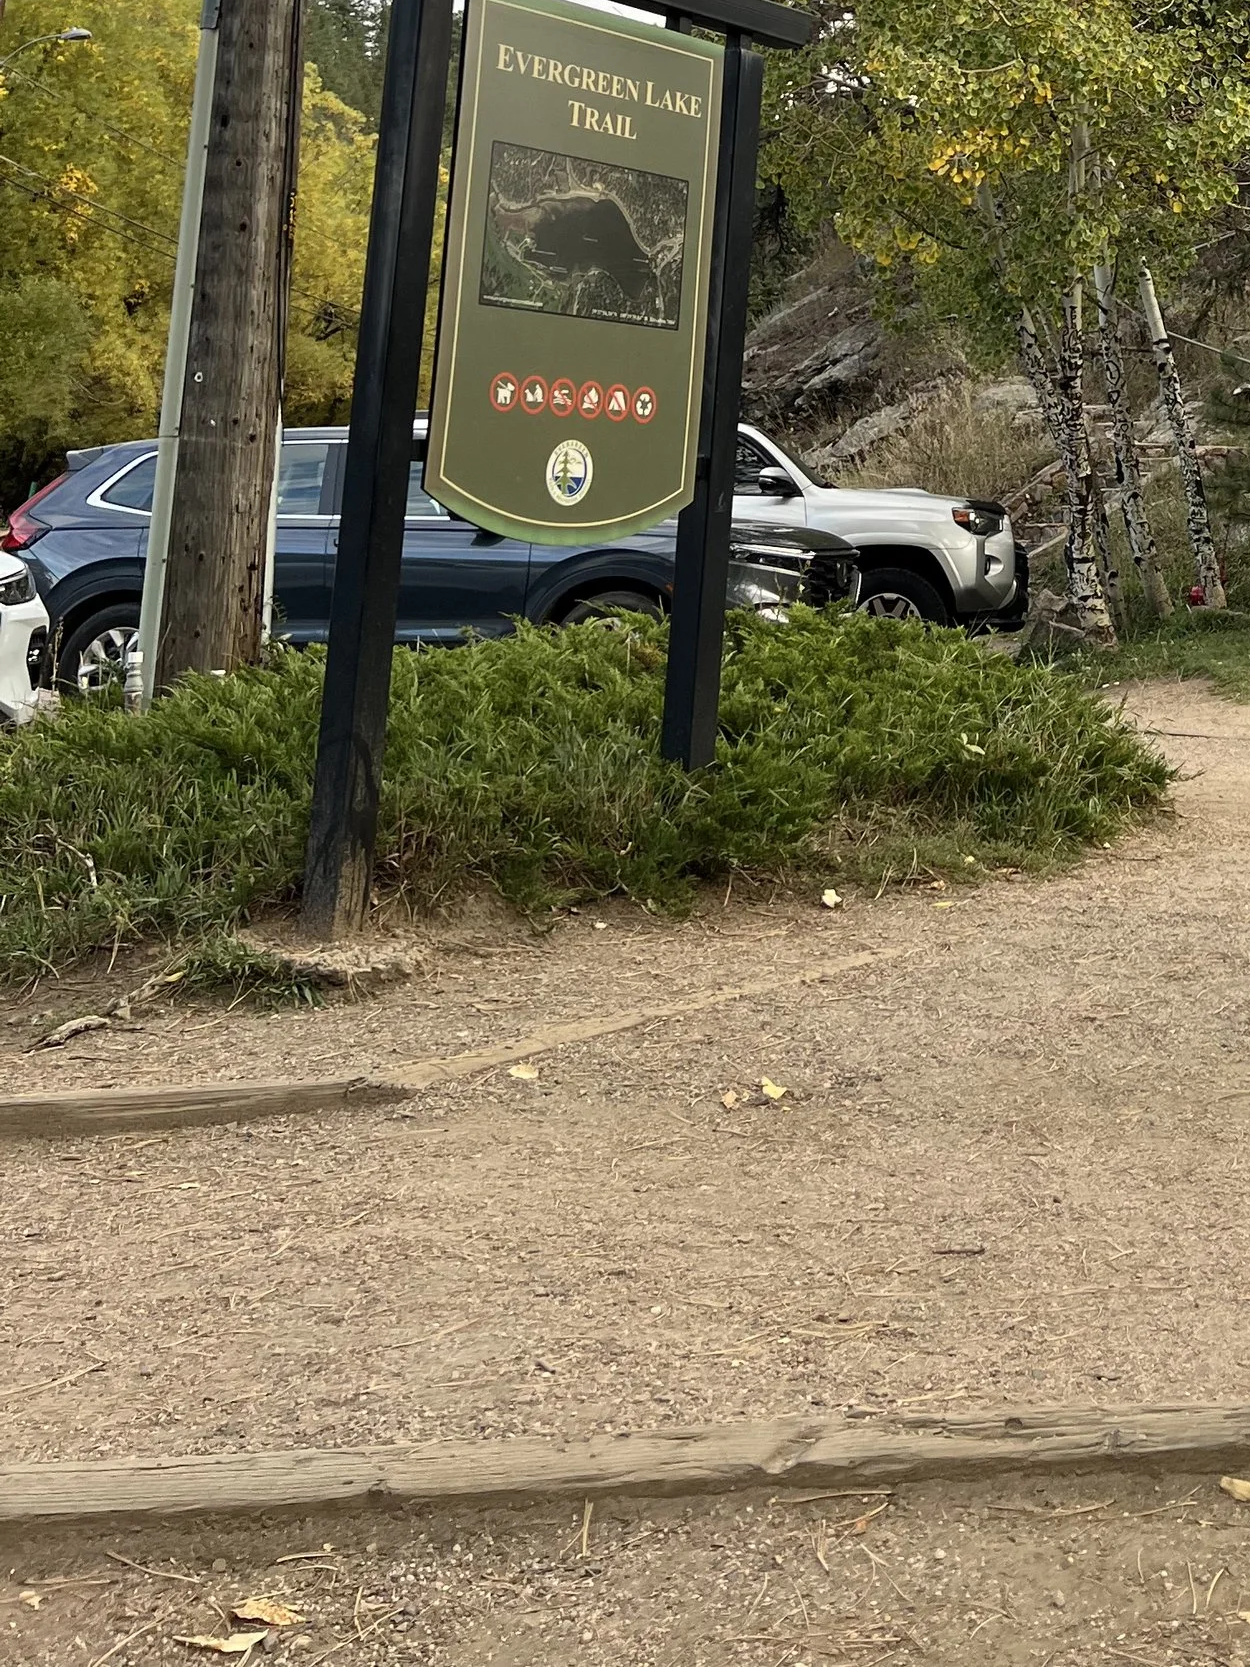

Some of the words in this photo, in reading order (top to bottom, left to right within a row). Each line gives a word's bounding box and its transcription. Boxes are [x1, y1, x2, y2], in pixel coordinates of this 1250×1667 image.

[496, 43, 640, 102] EVERGREEN
[645, 81, 702, 118] LAKE
[568, 100, 637, 140] TRAIL
